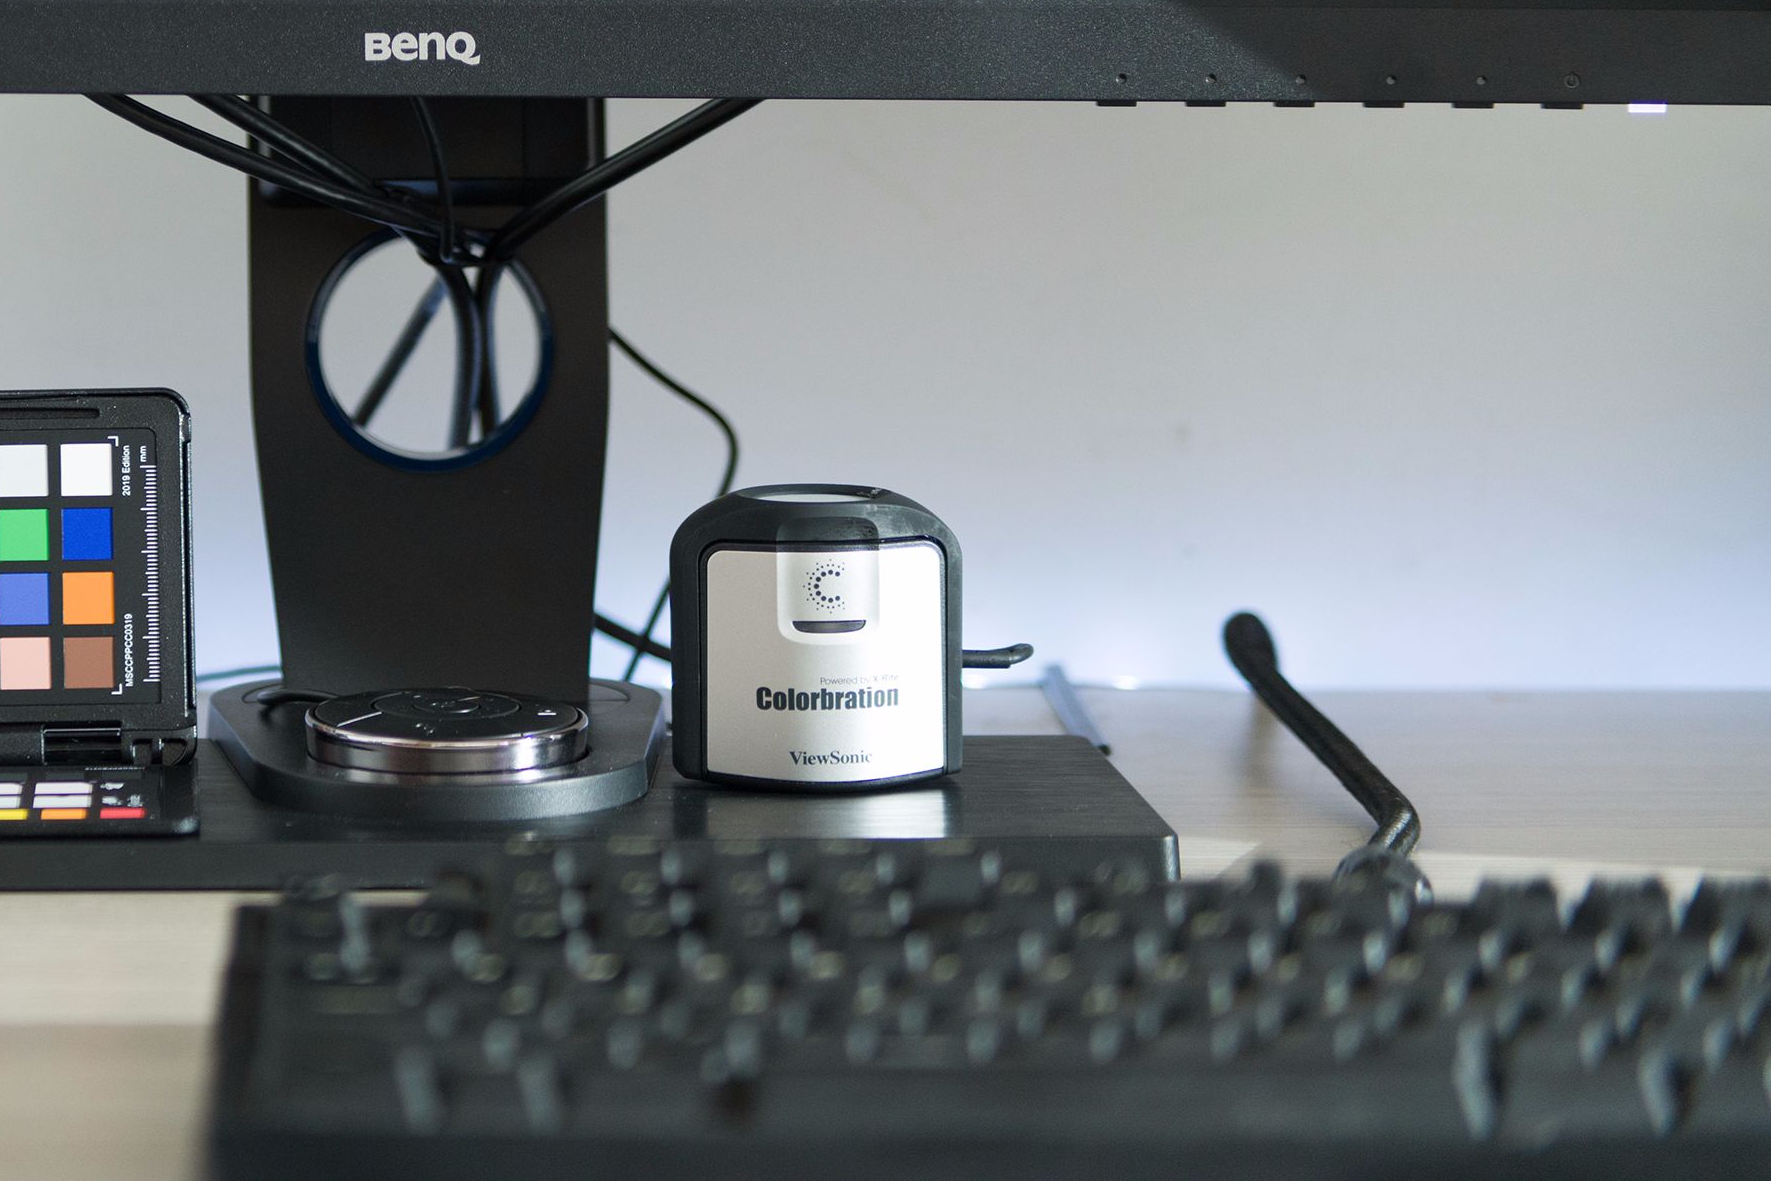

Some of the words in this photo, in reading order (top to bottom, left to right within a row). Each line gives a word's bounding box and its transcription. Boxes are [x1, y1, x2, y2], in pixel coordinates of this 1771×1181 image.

[364, 31, 481, 66] BenQ
[121, 445, 130, 474] Edition
[139, 445, 147, 462] mm
[121, 474, 131, 497] 2019
[124, 613, 134, 687] MSCCPPCC0319
[820, 676, 858, 686] Powered
[756, 686, 899, 712] Colorbration
[788, 750, 873, 766] ViewSonic
